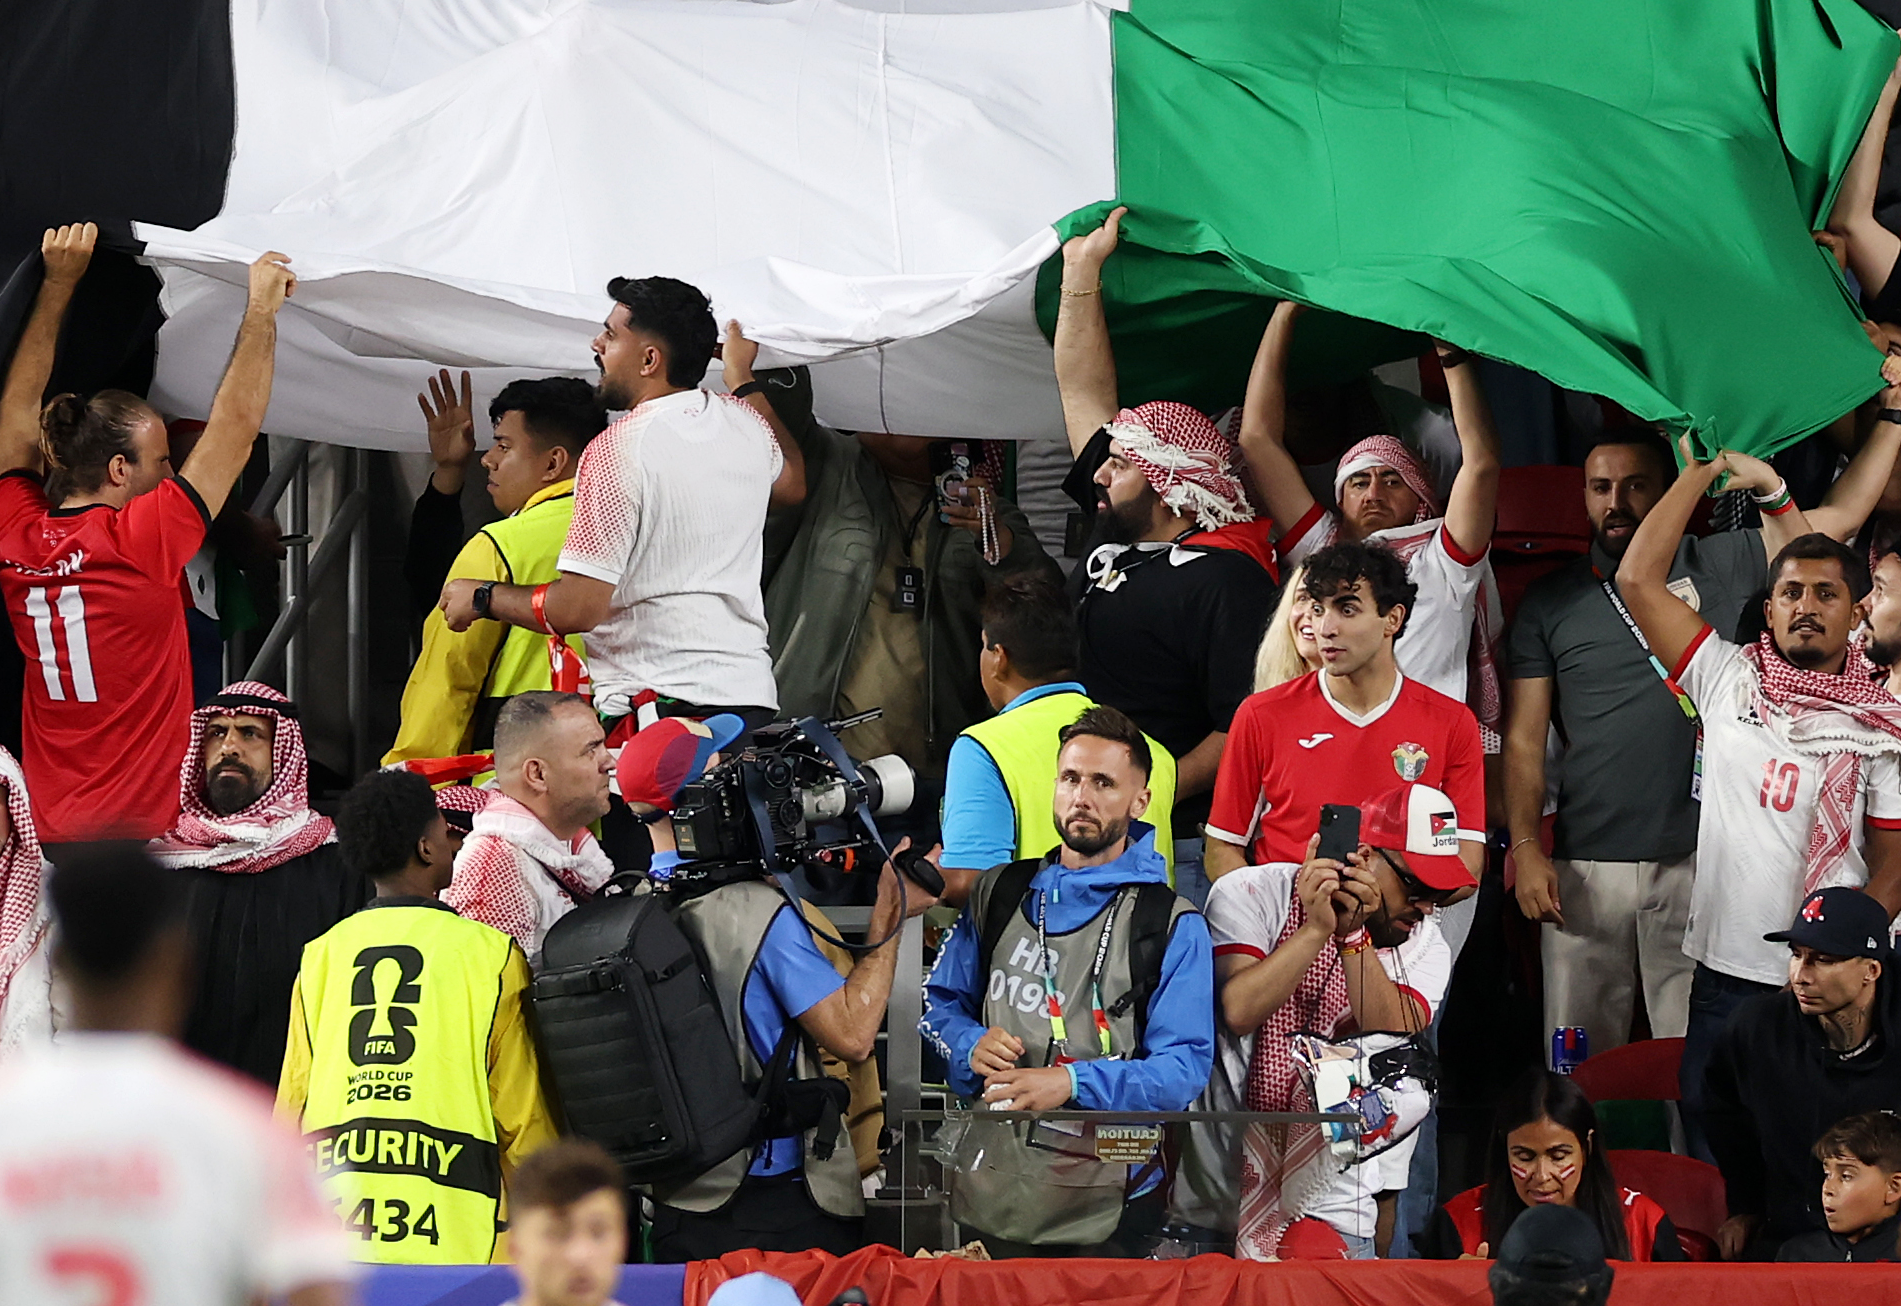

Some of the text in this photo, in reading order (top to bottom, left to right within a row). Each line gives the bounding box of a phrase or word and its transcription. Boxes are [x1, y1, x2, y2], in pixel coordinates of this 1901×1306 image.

[24, 584, 98, 704] 11
[1759, 757, 1801, 813] 10
[1432, 836, 1458, 848] Jorda
[1009, 936, 1061, 979] HB
[363, 1041, 396, 1056] FIFA
[346, 1083, 412, 1104] 2026
[347, 1070, 413, 1085] WORLD CUP
[335, 1198, 441, 1247] 434
